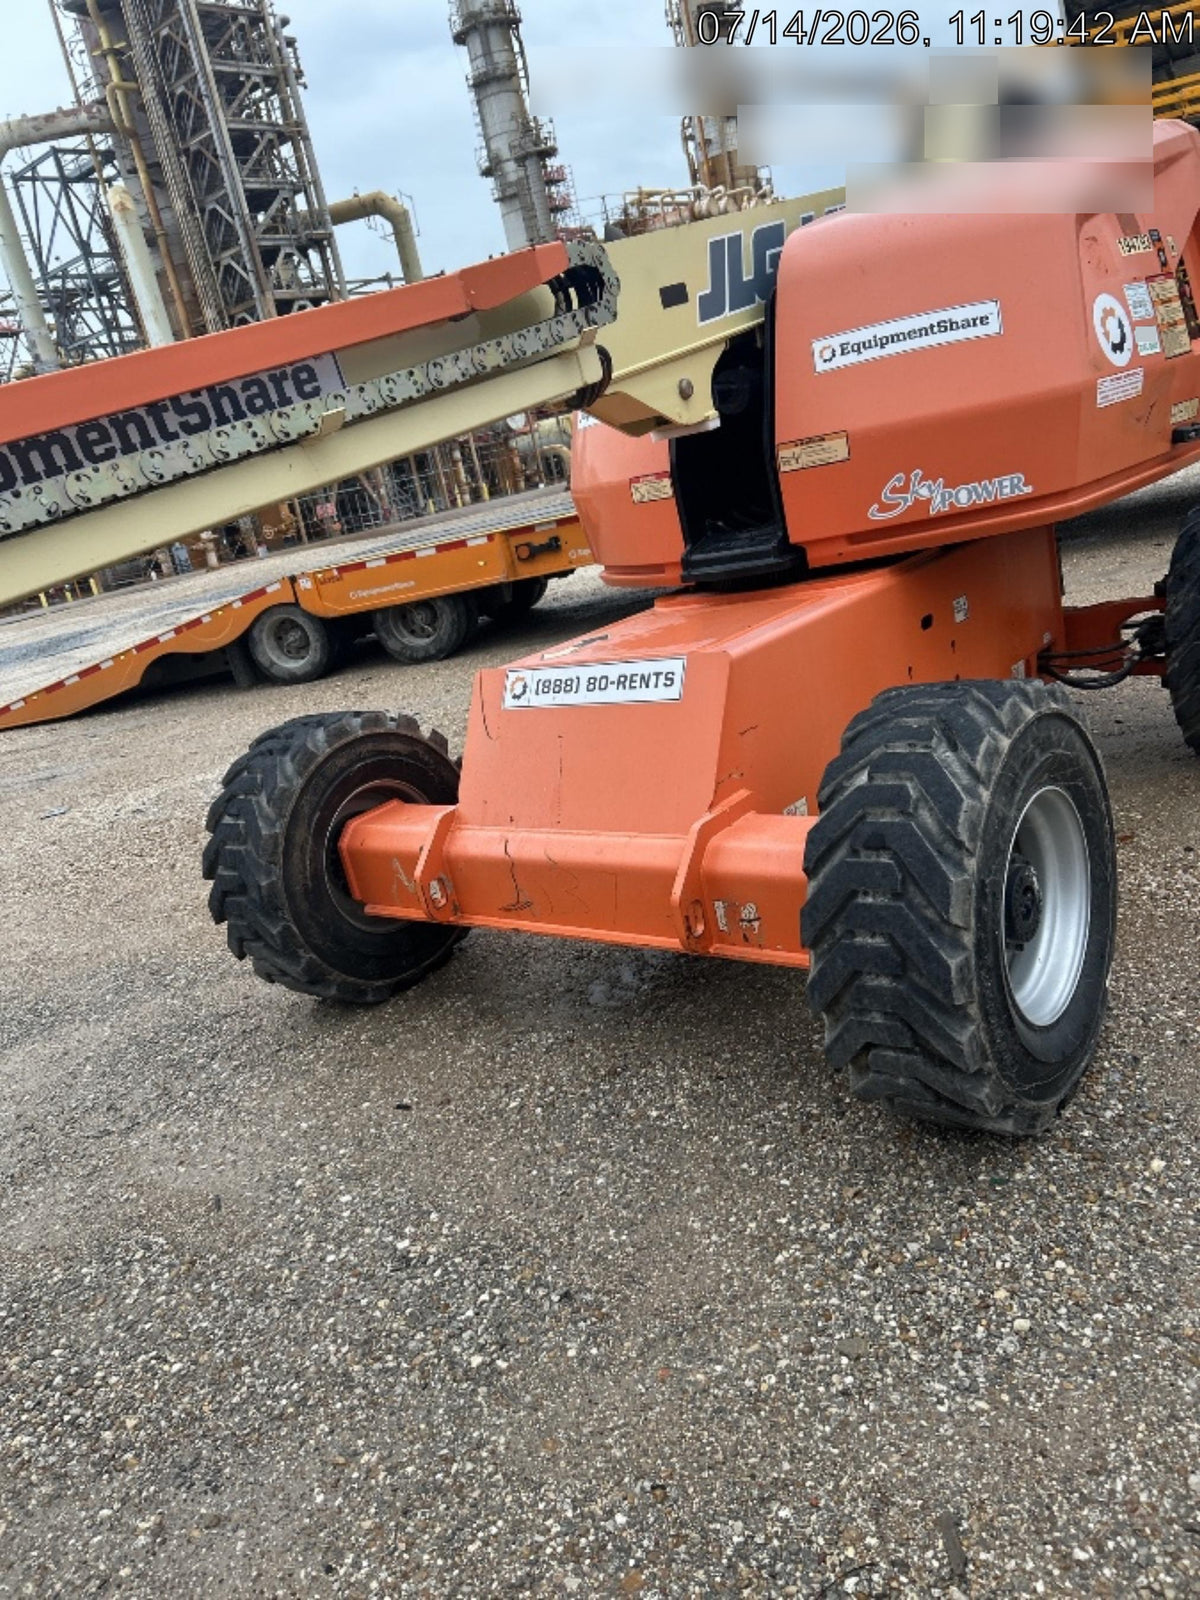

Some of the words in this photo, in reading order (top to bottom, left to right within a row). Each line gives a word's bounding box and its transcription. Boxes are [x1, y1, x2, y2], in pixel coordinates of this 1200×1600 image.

[697, 219, 786, 327] JLG
[839, 313, 991, 357] EquipmentShare
[535, 675, 581, 696] (888)
[586, 671, 676, 693] 80-RENTS
